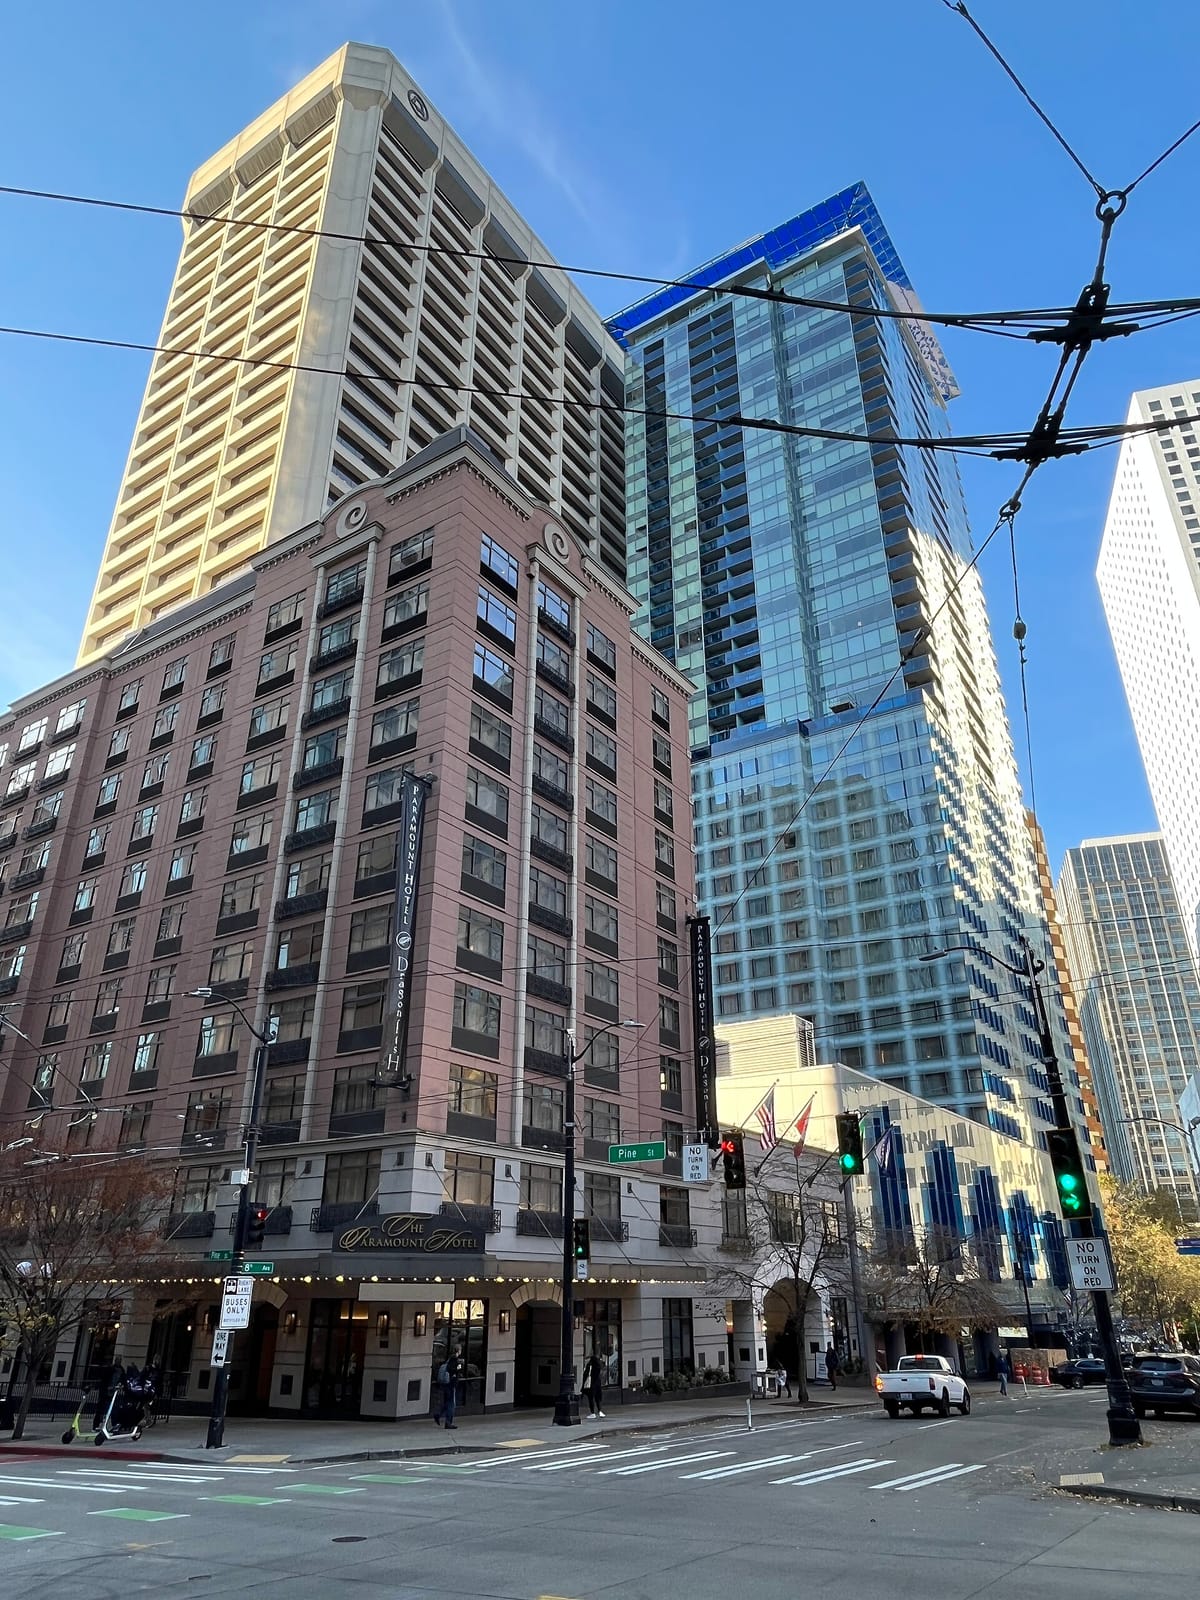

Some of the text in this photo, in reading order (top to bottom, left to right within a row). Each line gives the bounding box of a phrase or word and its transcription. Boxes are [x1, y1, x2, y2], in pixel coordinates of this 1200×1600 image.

[403, 785, 419, 925] PARAMOUNT HOTEL
[618, 1149, 655, 1159] Pine St
[689, 1147, 701, 1155] NO
[688, 1156, 703, 1164] TURN
[689, 1172, 702, 1180] RED
[339, 1226, 479, 1252] PARAMOUNT HOTEL
[1076, 1241, 1095, 1253] NO
[1075, 1255, 1100, 1265] TURN
[1083, 1266, 1097, 1275] ON
[1083, 1277, 1102, 1286] RED
[225, 1298, 248, 1306] BUSES
[226, 1306, 245, 1314] ONLY
[216, 1332, 227, 1341] ONE
